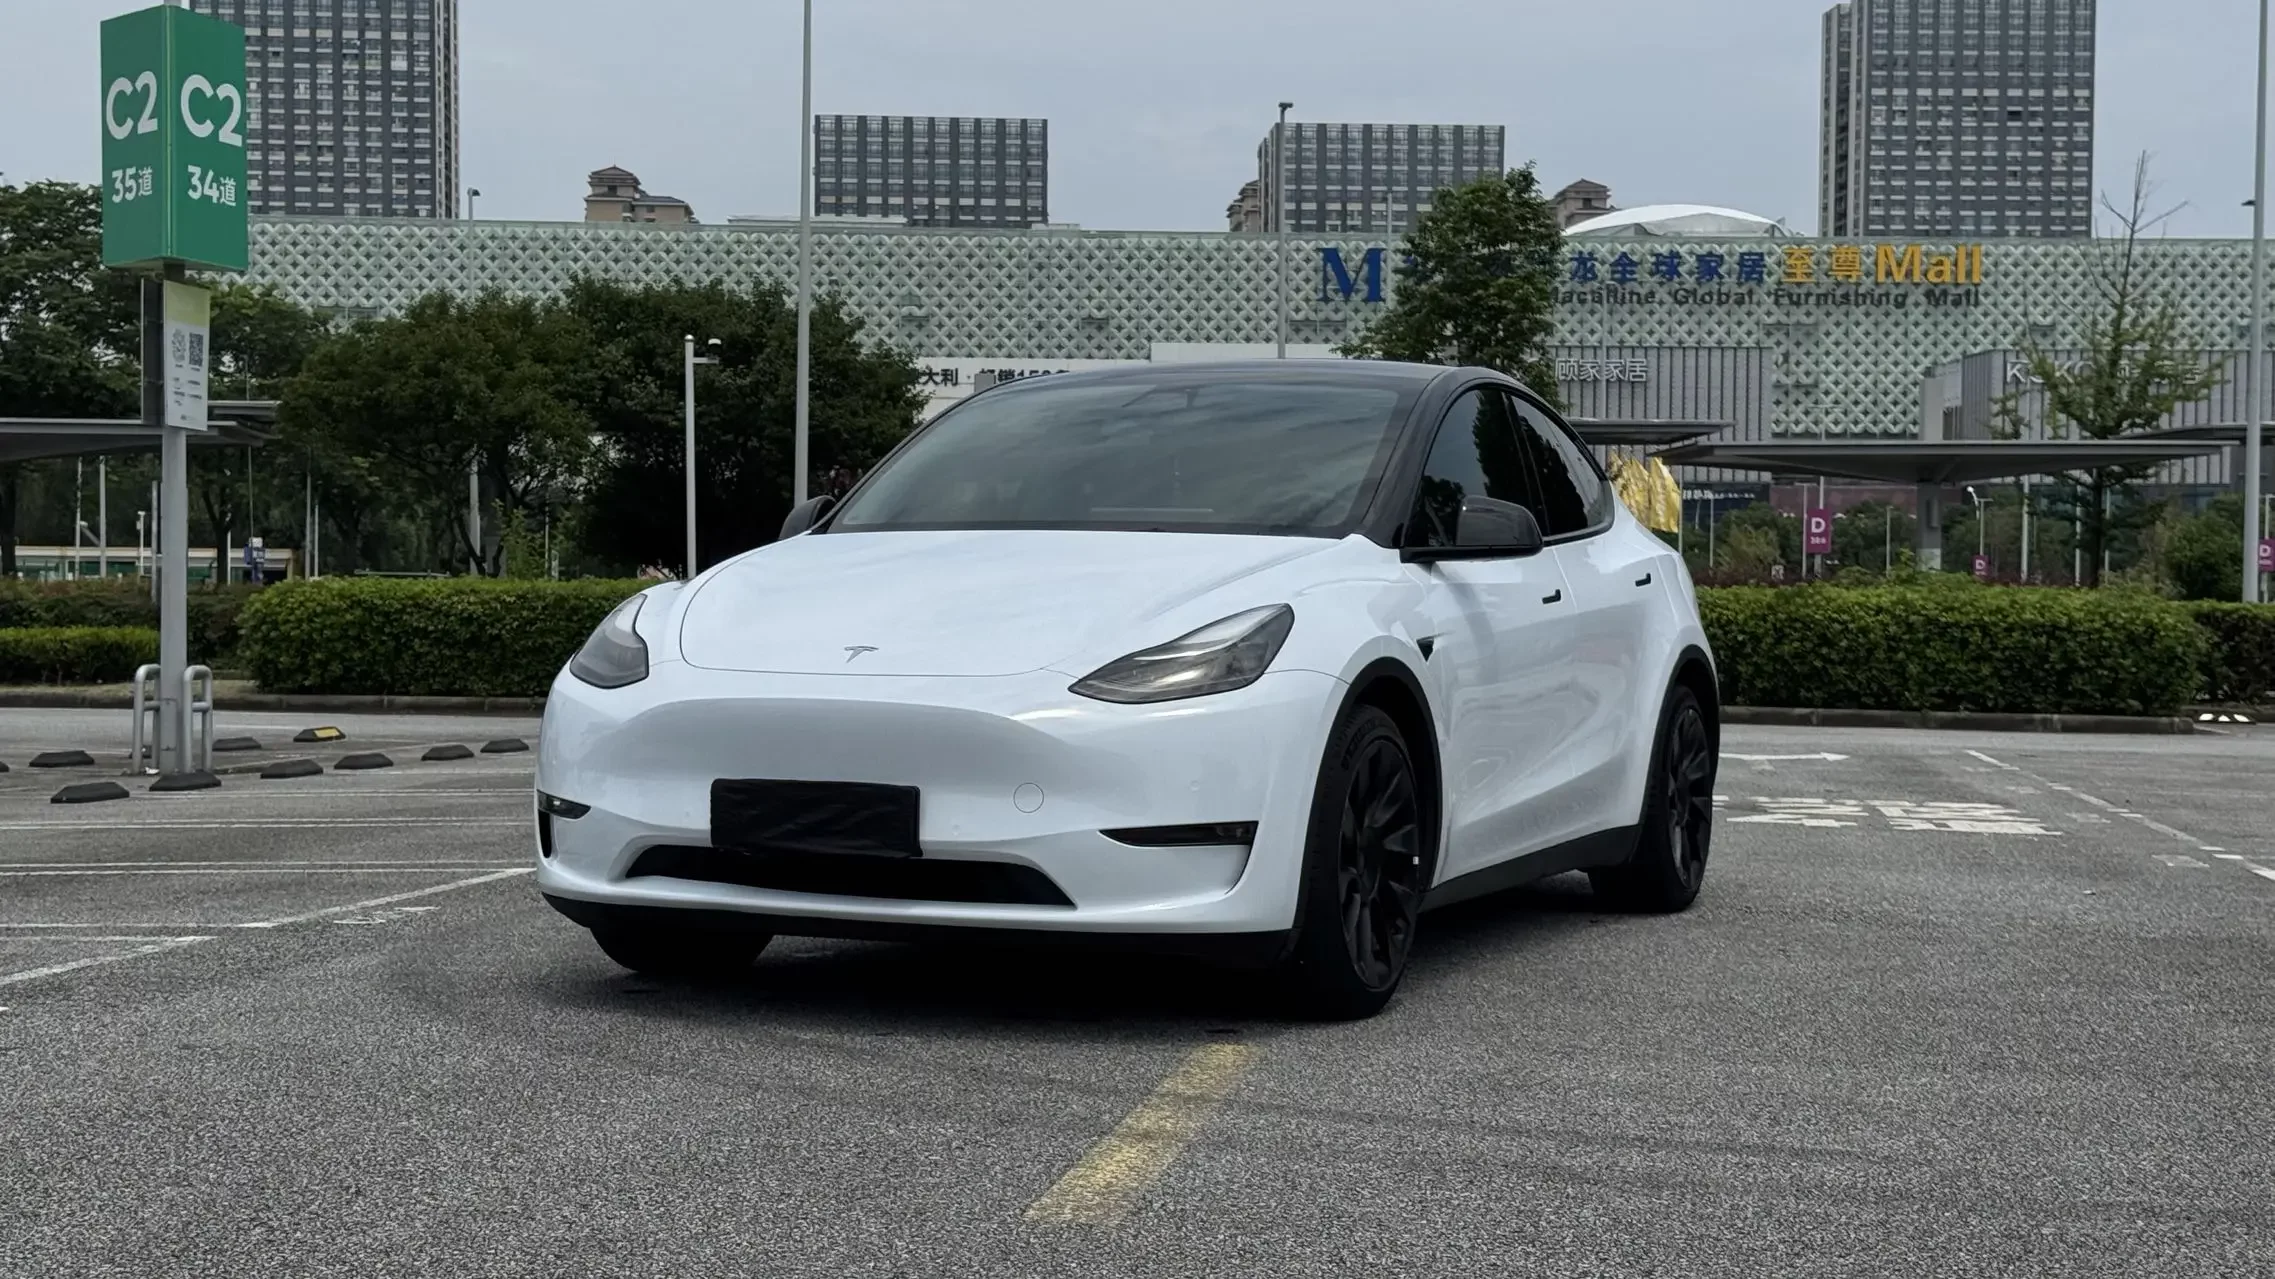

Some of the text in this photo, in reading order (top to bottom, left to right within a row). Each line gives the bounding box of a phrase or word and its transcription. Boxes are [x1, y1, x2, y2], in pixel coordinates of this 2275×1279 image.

[106, 70, 158, 140] C2
[180, 74, 243, 147] C2
[111, 165, 153, 203] 35道
[187, 164, 237, 206] 34道
[1316, 247, 1387, 303] M
[1875, 244, 1983, 285] Mall
[1673, 287, 1753, 304] Global
[1773, 287, 1909, 309] Furnishing
[1922, 287, 1980, 306] Mall
[1554, 357, 1649, 381] 顾家家居
[1811, 516, 1826, 533] D
[2259, 544, 2272, 557] D
